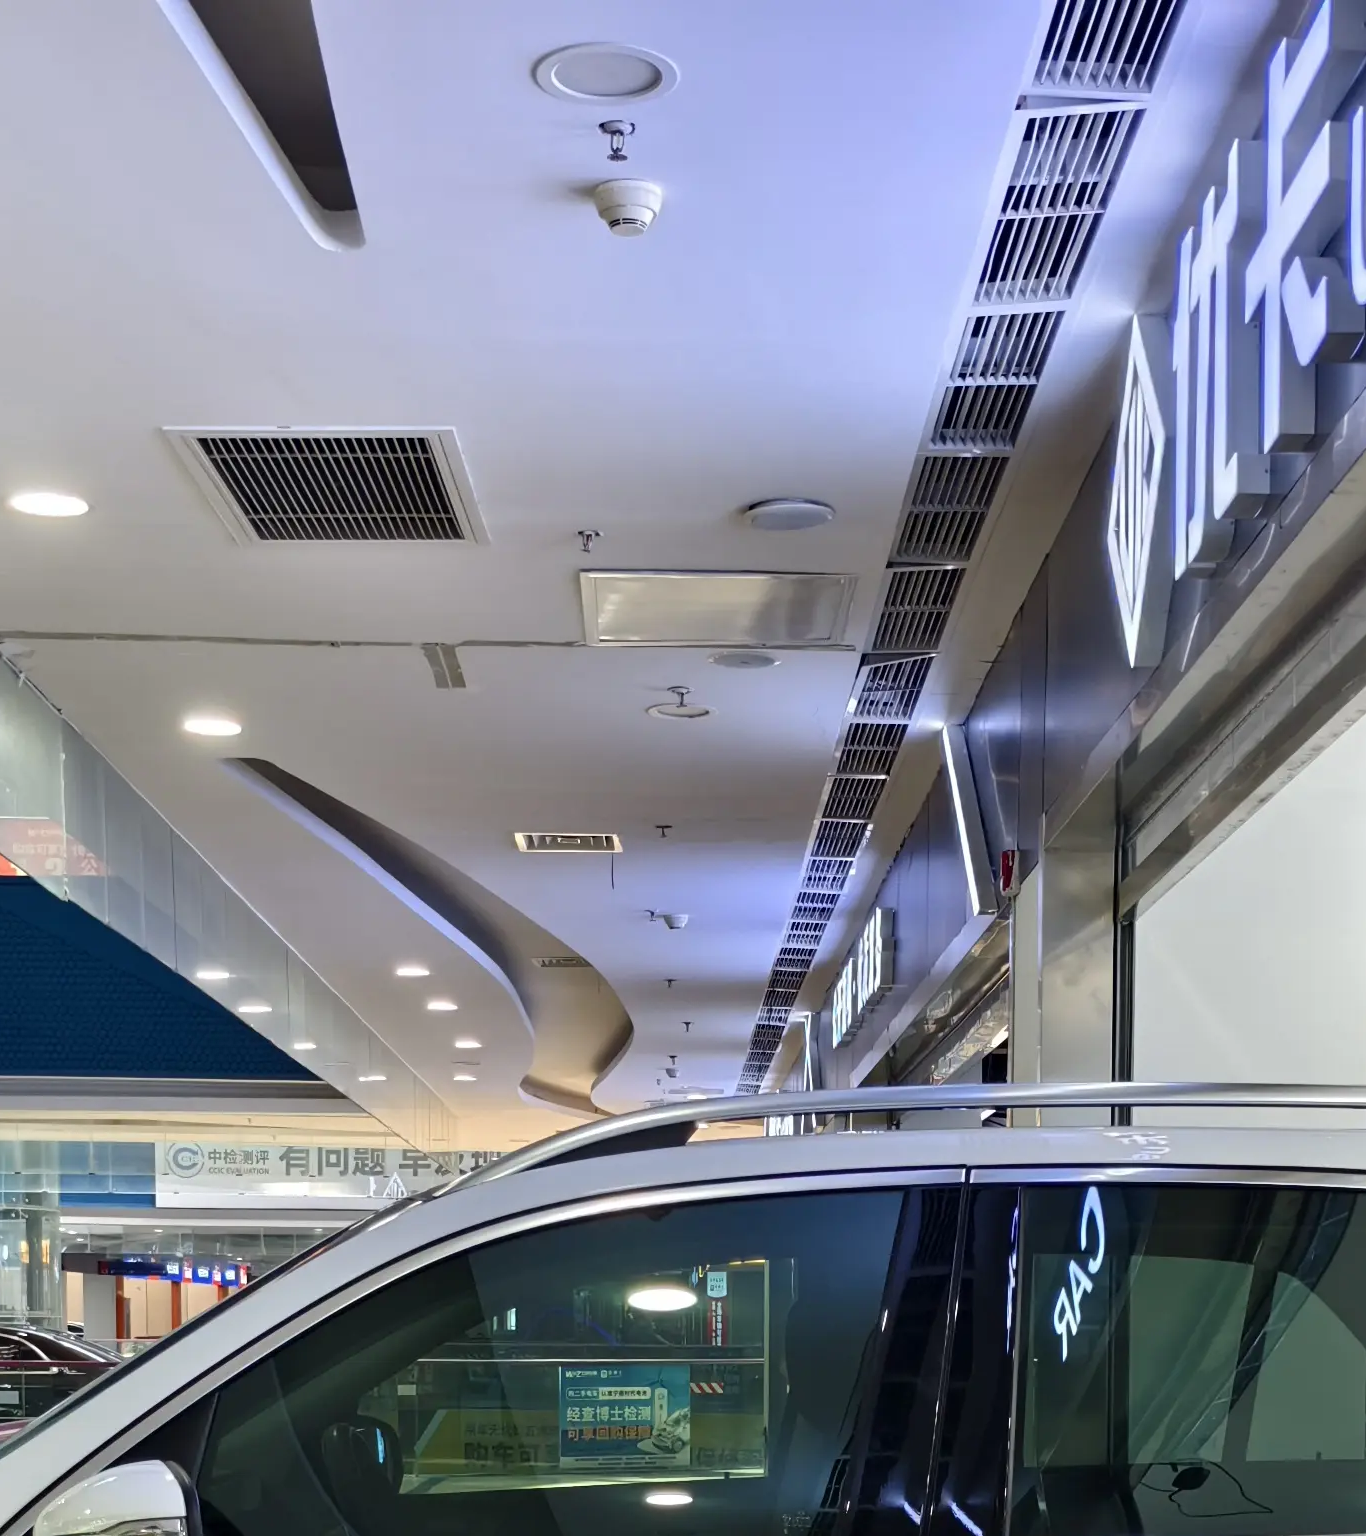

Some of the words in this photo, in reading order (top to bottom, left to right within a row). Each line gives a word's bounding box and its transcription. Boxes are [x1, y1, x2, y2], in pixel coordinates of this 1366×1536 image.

[208, 1148, 270, 1166] 中检测评
[279, 1147, 385, 1177] 有问题
[566, 1405, 651, 1422] 经查博士检测
